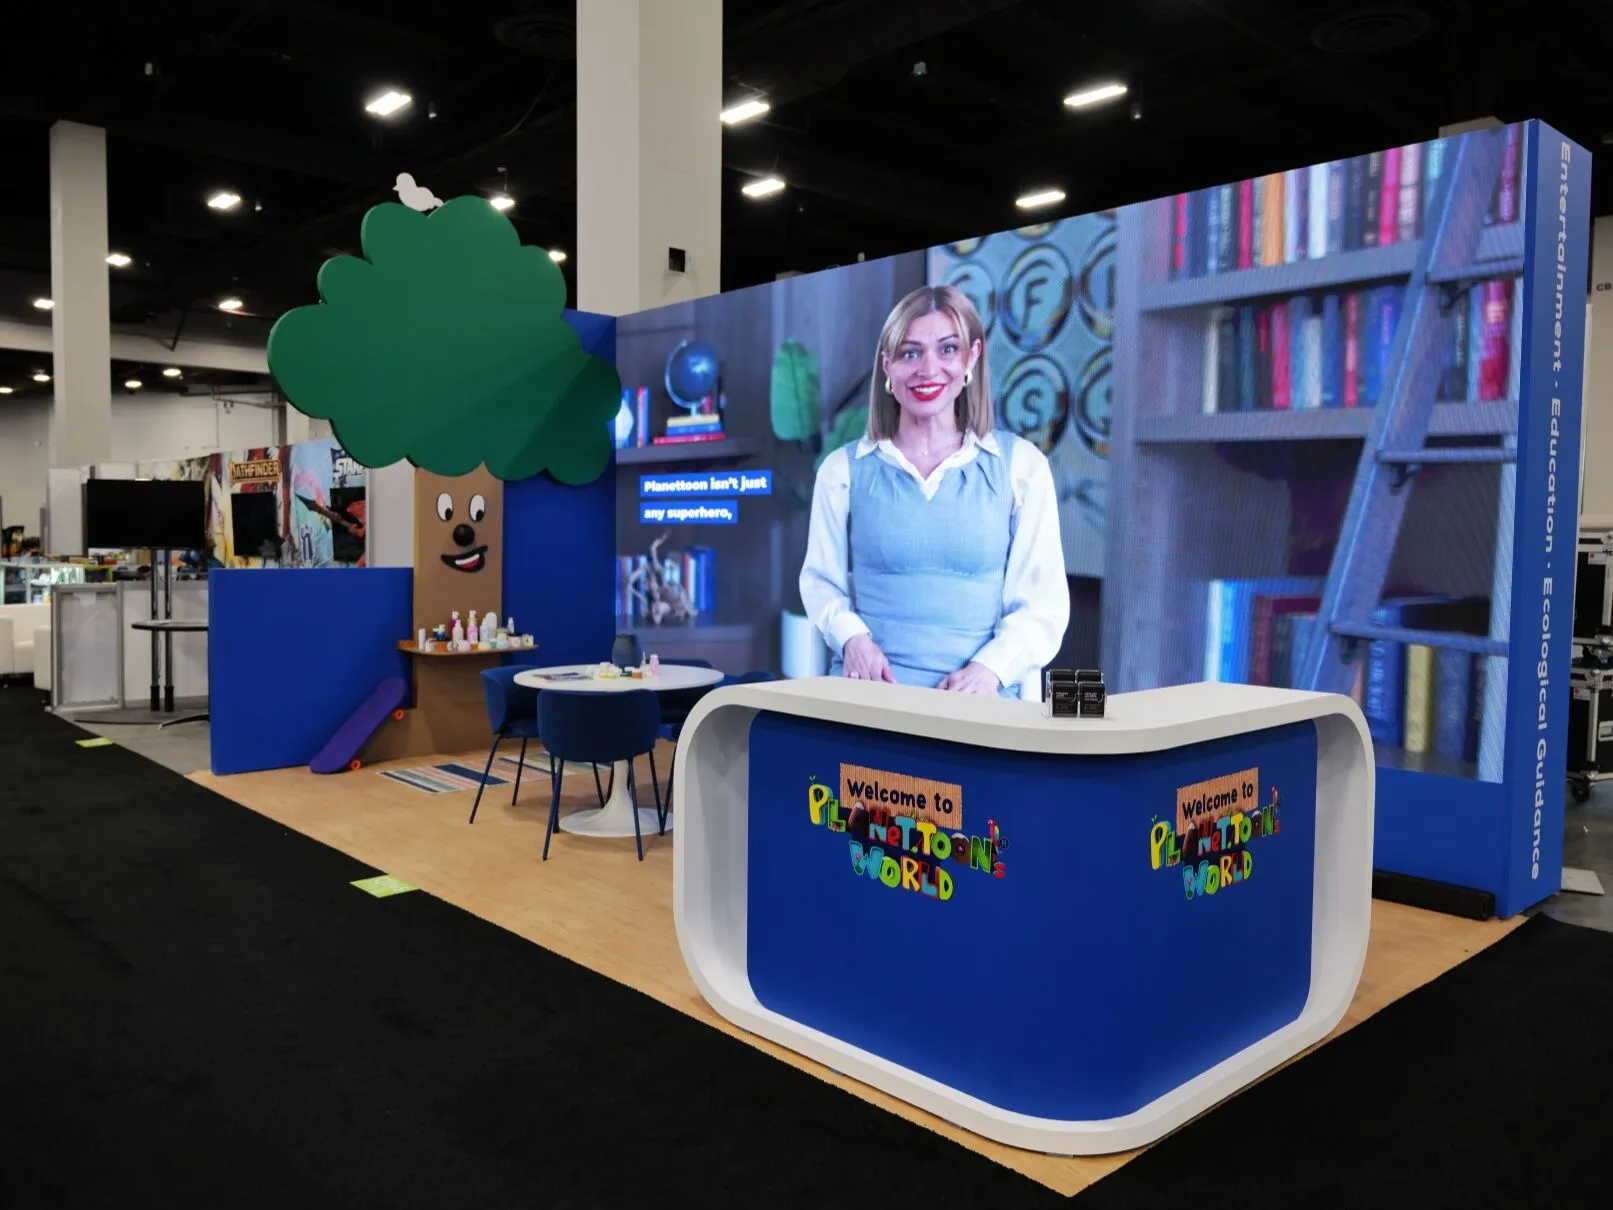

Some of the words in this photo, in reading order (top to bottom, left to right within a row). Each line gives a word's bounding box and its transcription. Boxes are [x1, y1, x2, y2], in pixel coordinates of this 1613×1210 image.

[1552, 141, 1571, 373] Entertainment
[644, 480, 708, 492] Planettoon
[710, 476, 739, 490] isn't
[740, 475, 767, 492] just
[1545, 398, 1561, 553] Education
[644, 508, 666, 521] any
[667, 505, 732, 521] superhero,
[1537, 577, 1553, 730] Ecological
[847, 778, 927, 809] Welcome
[934, 792, 954, 814] to
[1182, 786, 1238, 821] Welcome
[1242, 781, 1254, 800] to
[1531, 738, 1547, 880] Guidance
[849, 840, 954, 901] WORLD
[1183, 850, 1253, 900] WORLD
